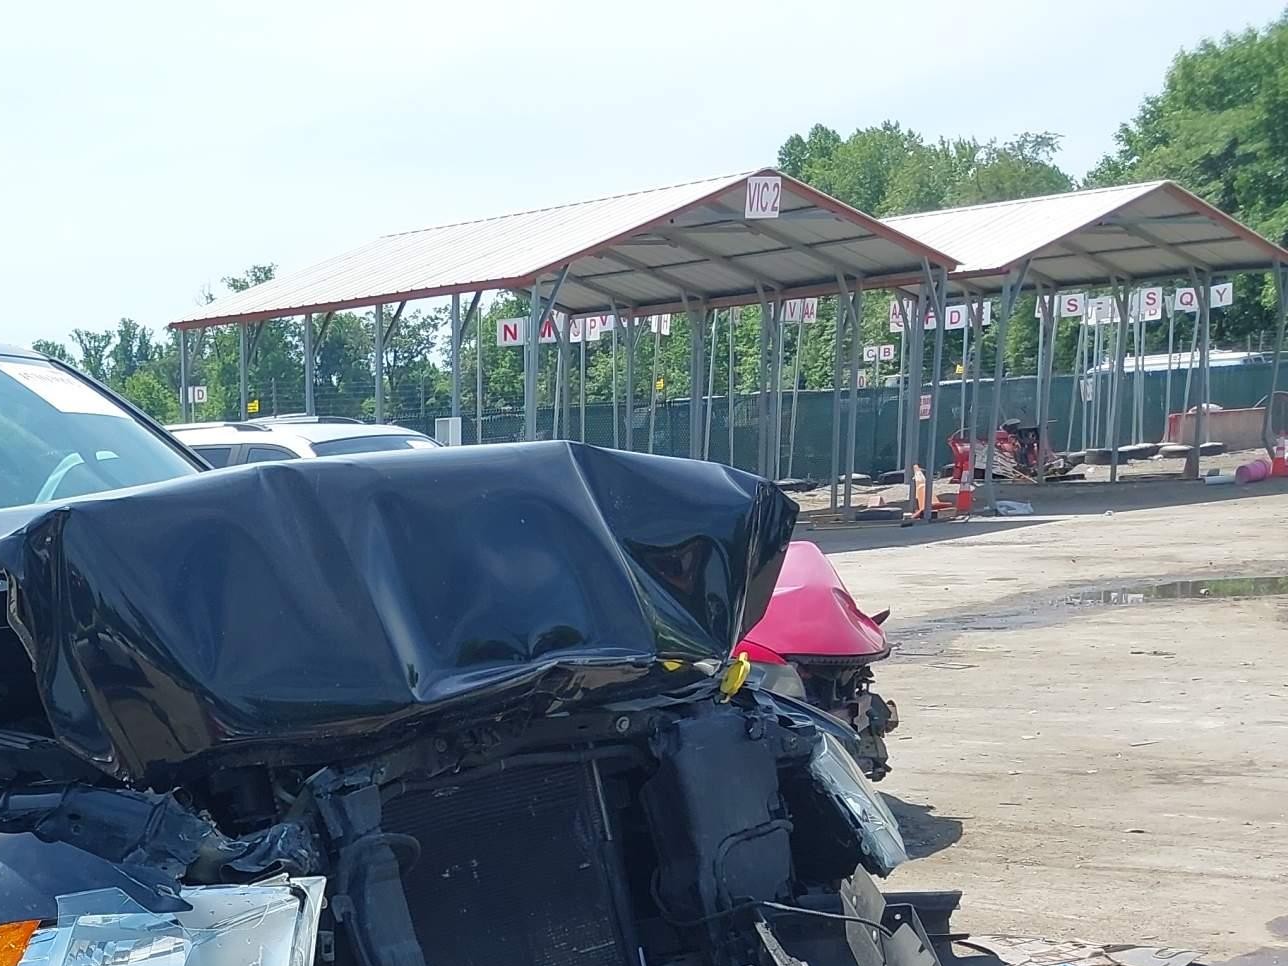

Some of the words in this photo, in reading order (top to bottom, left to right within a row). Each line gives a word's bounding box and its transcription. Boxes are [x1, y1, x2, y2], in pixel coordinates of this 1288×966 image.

[748, 182, 769, 212] VIC
[771, 182, 780, 212] 2
[1145, 291, 1157, 305] S
[1179, 291, 1194, 306] Q
[1216, 287, 1227, 302] Y
[788, 302, 797, 316] V
[803, 303, 816, 318] AA
[1066, 298, 1078, 312] S
[950, 310, 961, 325] D
[503, 323, 518, 341] N
[866, 349, 875, 359] C
[883, 347, 891, 357] B
[197, 389, 205, 400] D
